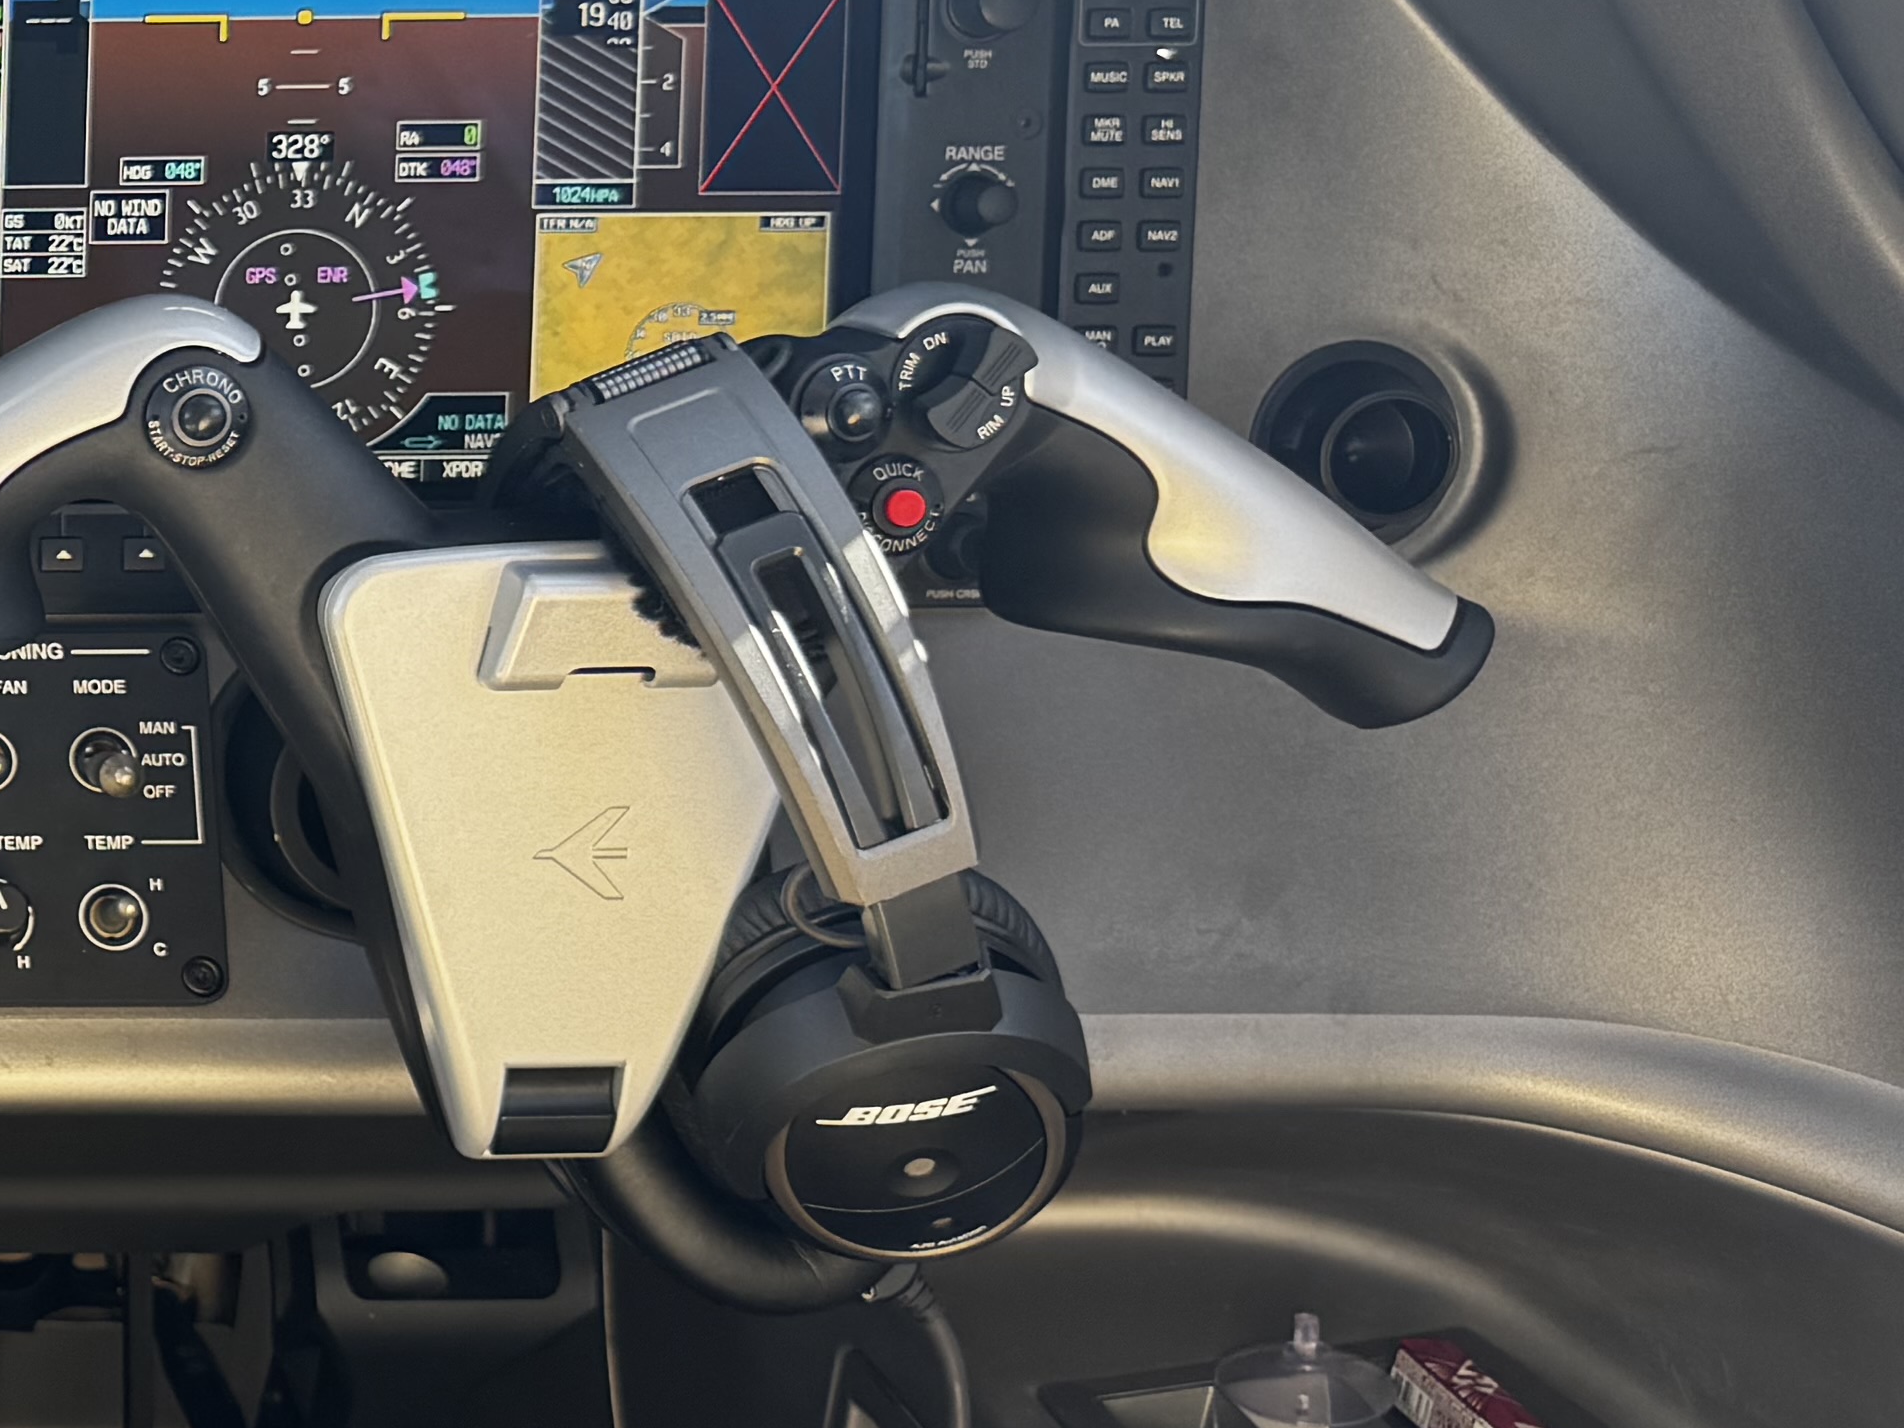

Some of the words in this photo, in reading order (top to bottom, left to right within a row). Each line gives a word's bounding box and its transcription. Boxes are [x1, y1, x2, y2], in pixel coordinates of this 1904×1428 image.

[1150, 177, 1180, 188] NAV1
[162, 368, 243, 406] CHRONO
[815, 1085, 997, 1126] BOSE
